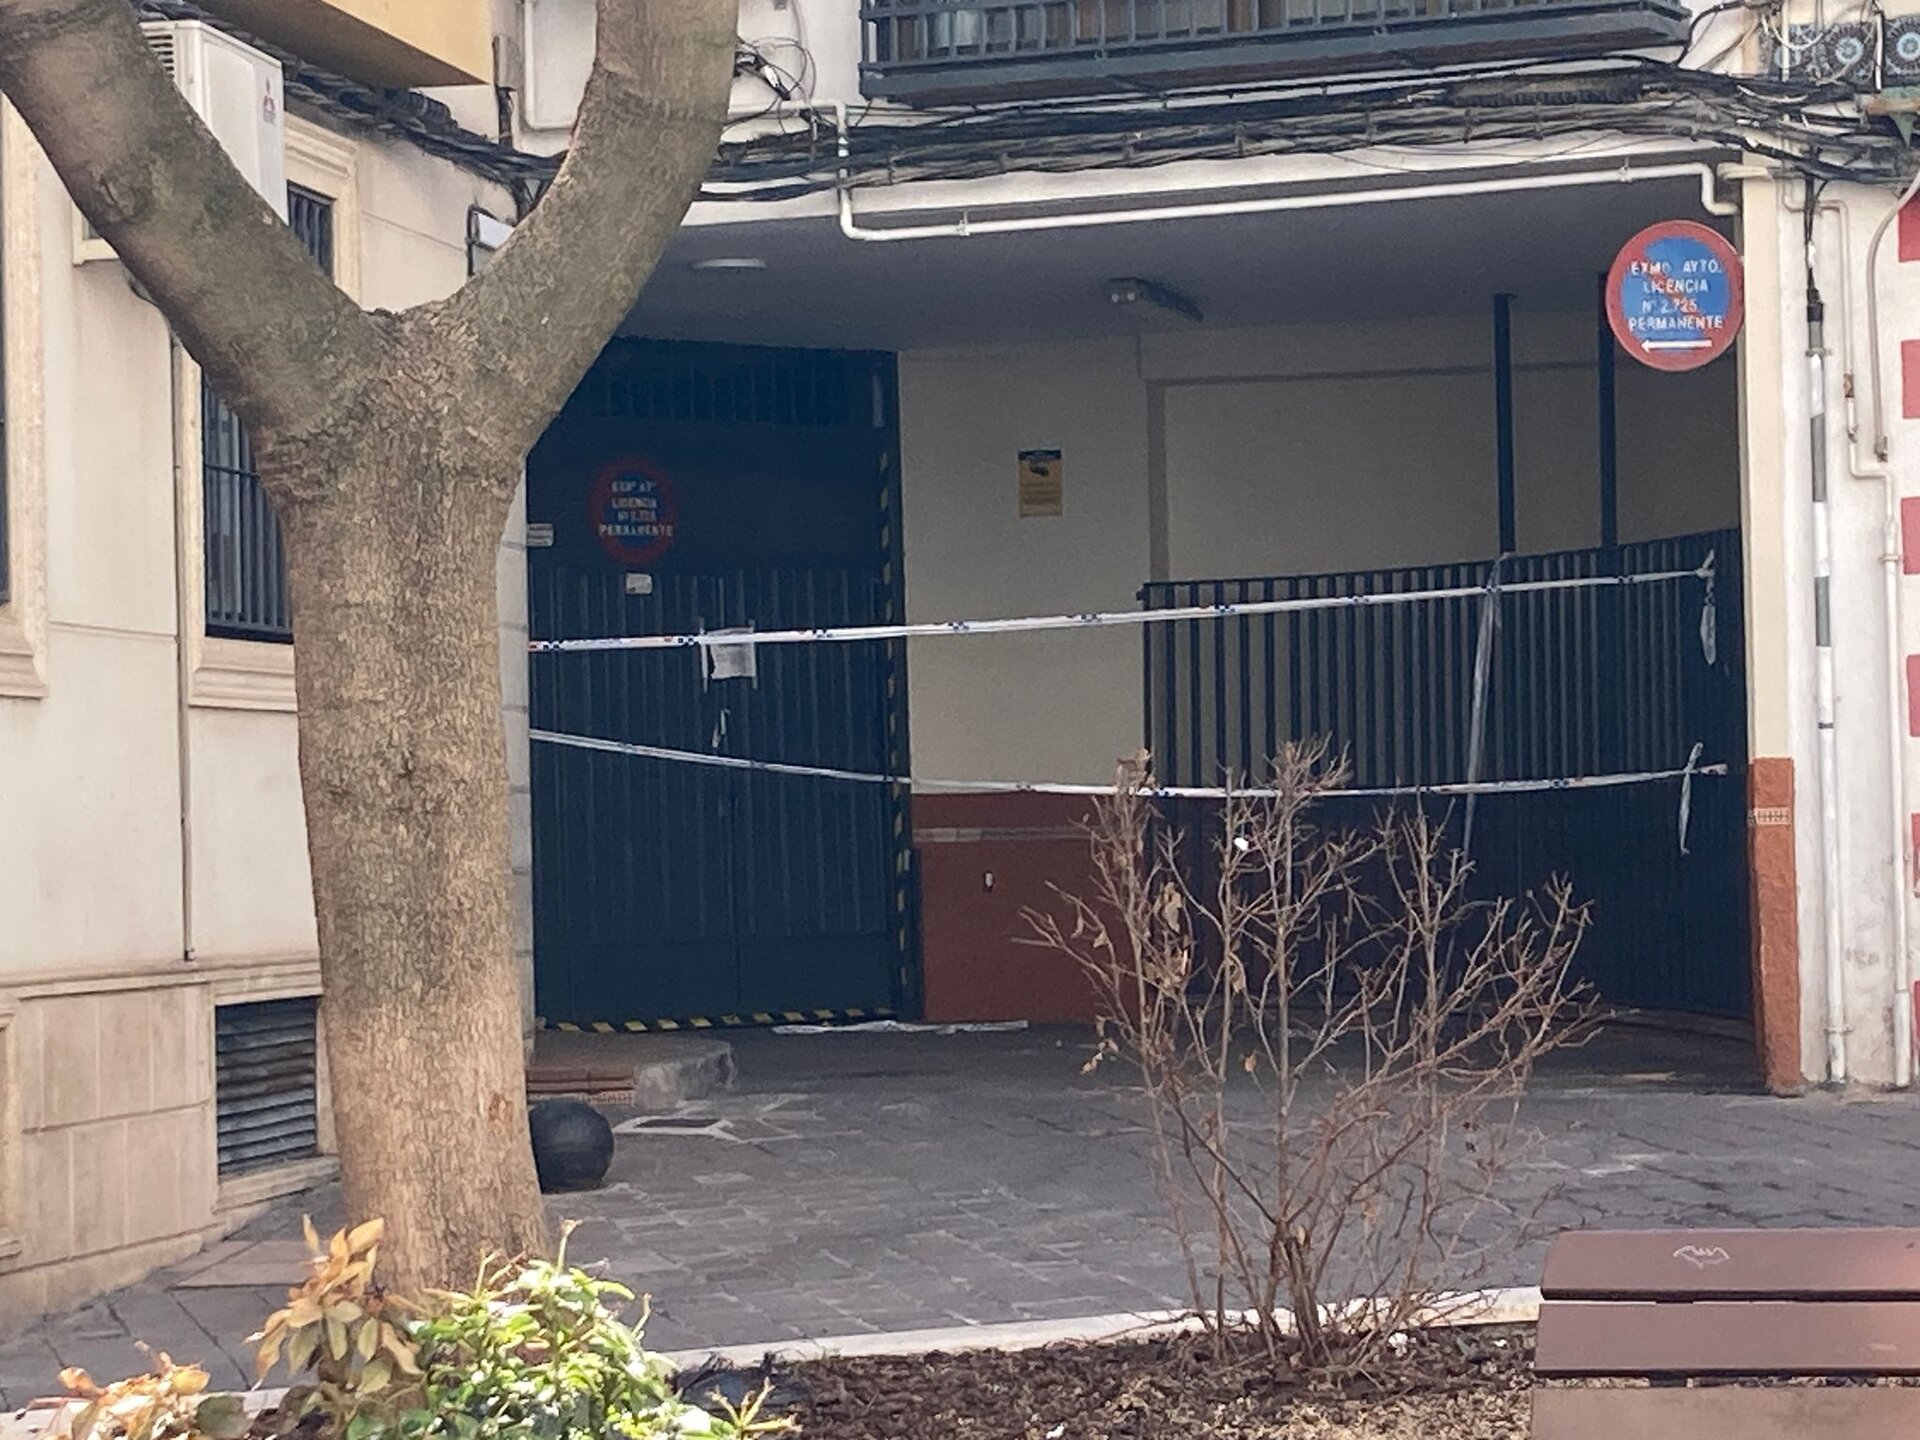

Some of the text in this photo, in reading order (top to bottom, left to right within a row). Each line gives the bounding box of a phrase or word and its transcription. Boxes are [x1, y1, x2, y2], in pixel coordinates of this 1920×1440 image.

[1643, 278, 1709, 294] LICENCIA
[1628, 315, 1723, 332] PERMANENTE
[599, 523, 673, 537] PERMANENTE
